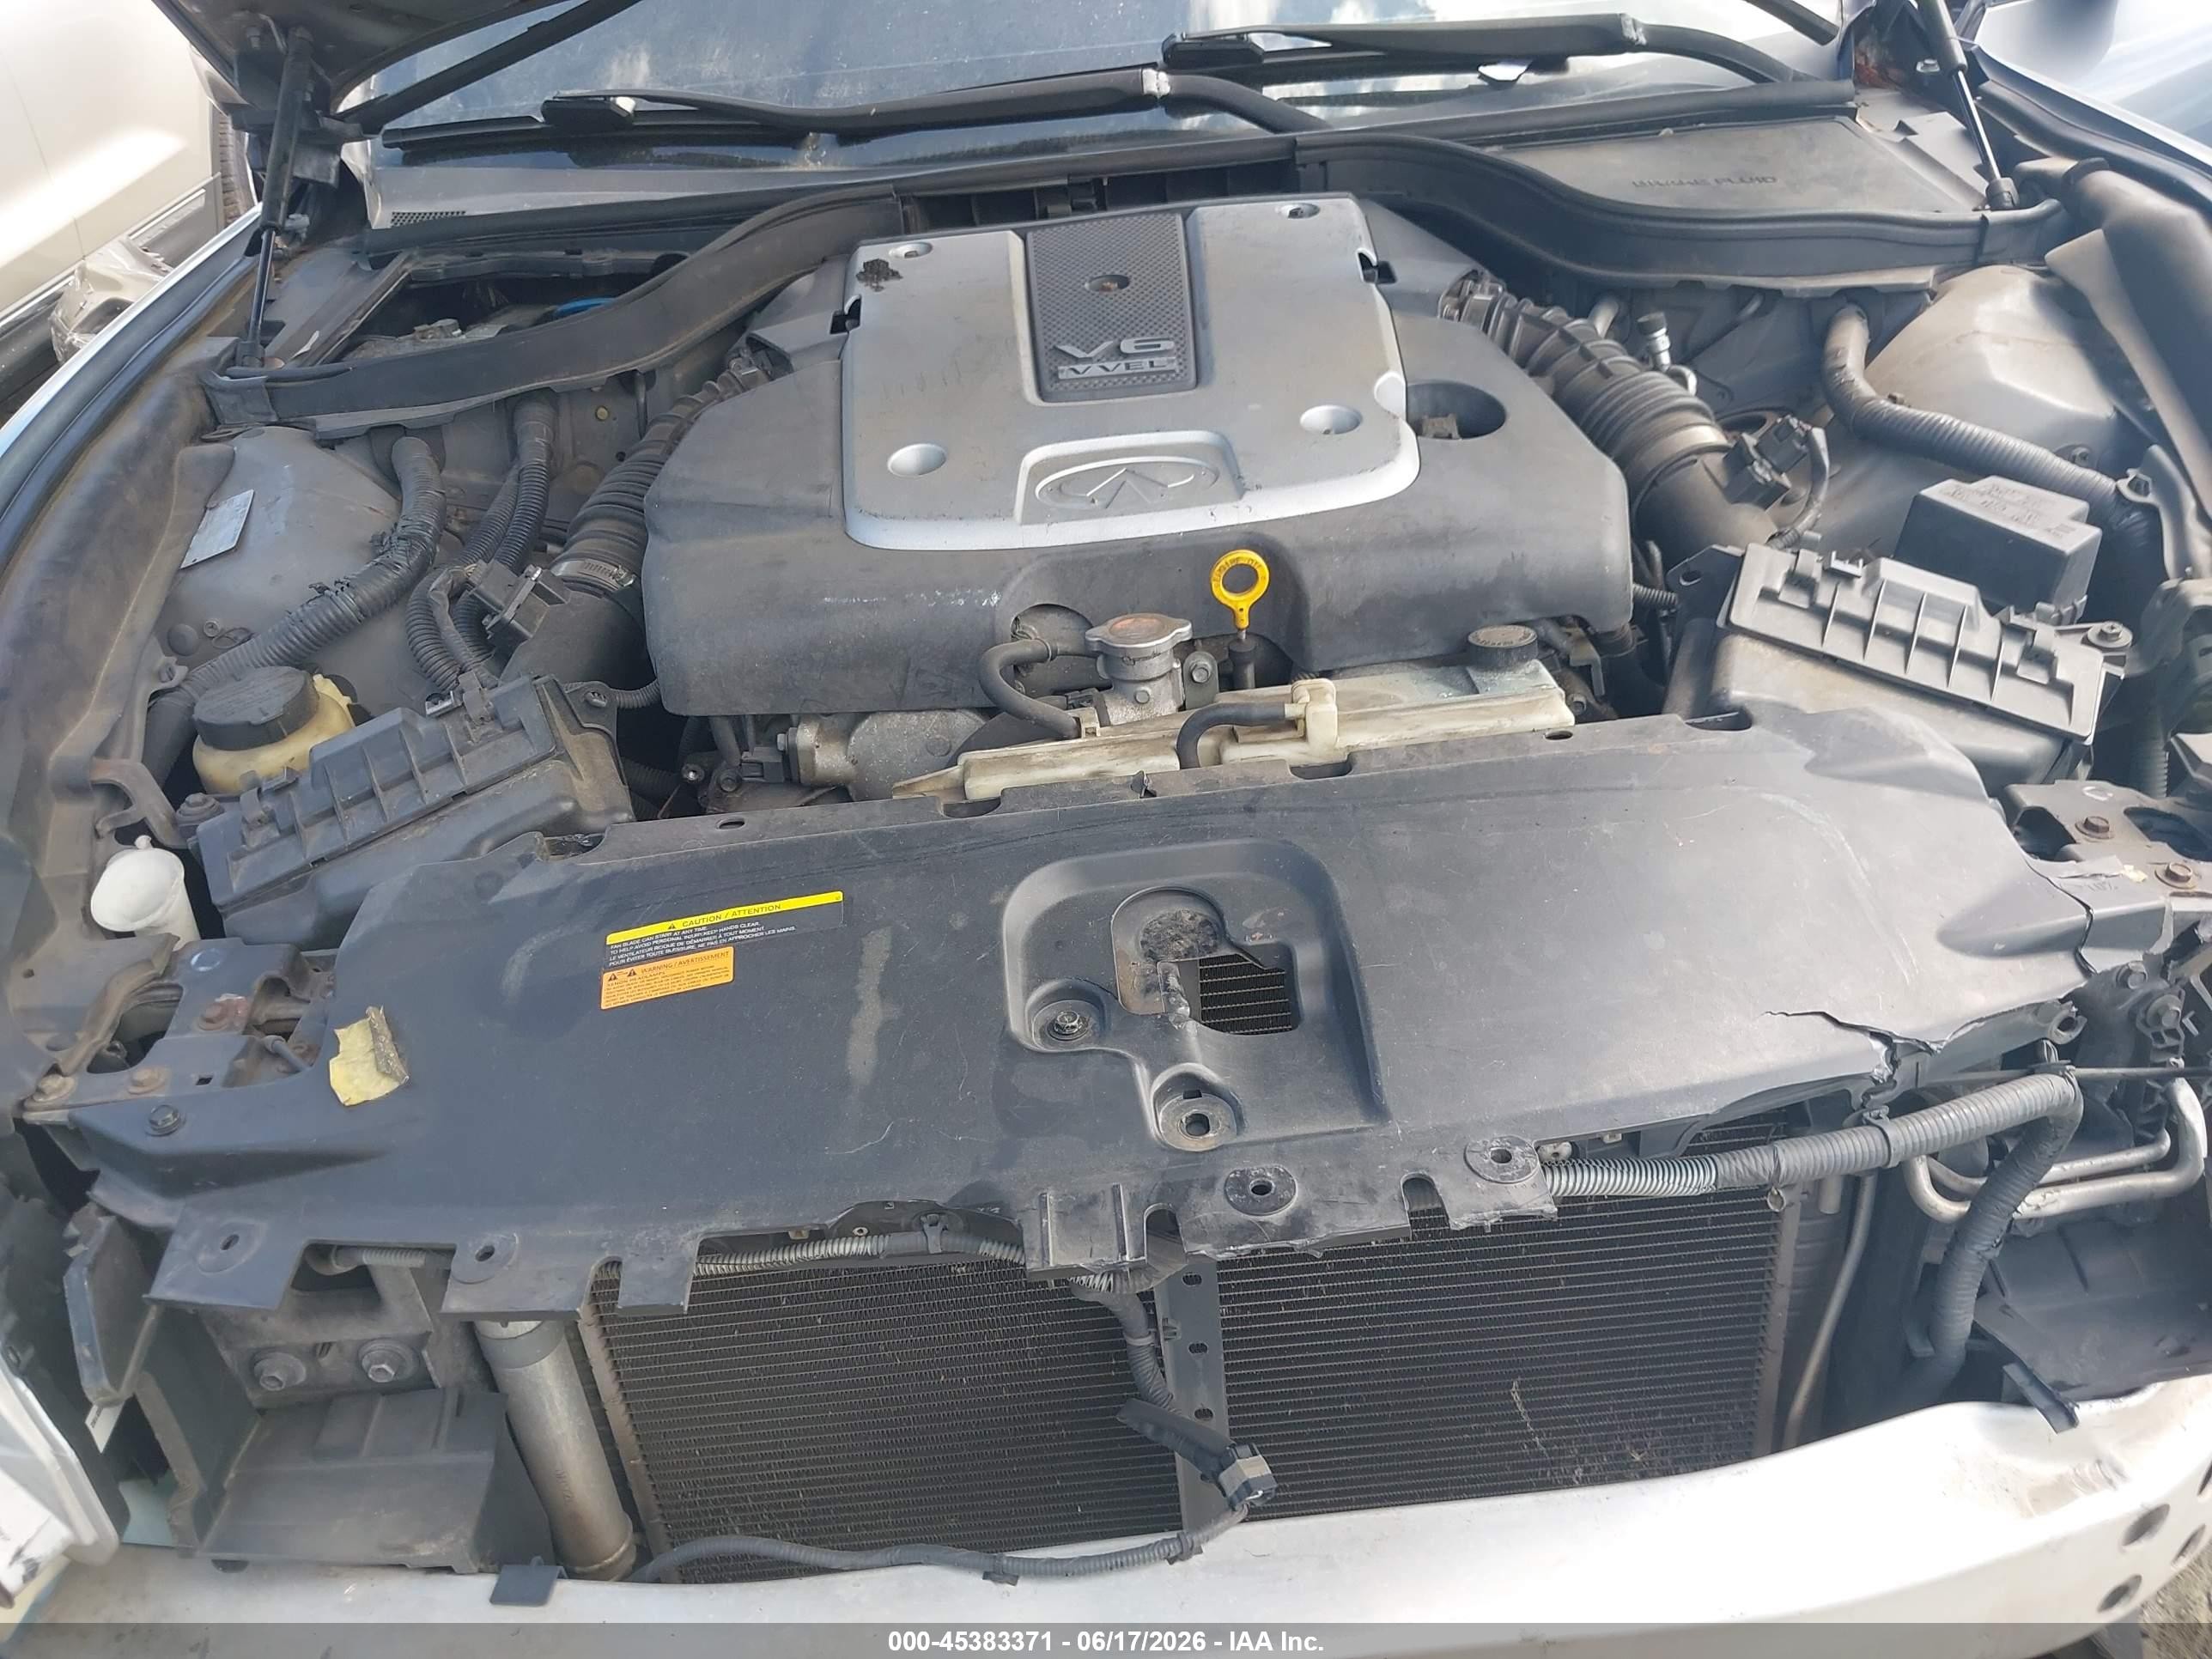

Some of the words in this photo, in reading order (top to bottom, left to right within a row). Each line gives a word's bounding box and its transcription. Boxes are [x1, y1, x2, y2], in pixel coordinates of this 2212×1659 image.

[1054, 337, 1175, 361] V6
[1068, 360, 1167, 375] VVEL
[682, 914, 721, 927] CAUTION
[731, 903, 781, 917] ATTENTION
[641, 963, 673, 974] WARNING
[678, 951, 730, 967] AVERTISSEMENT
